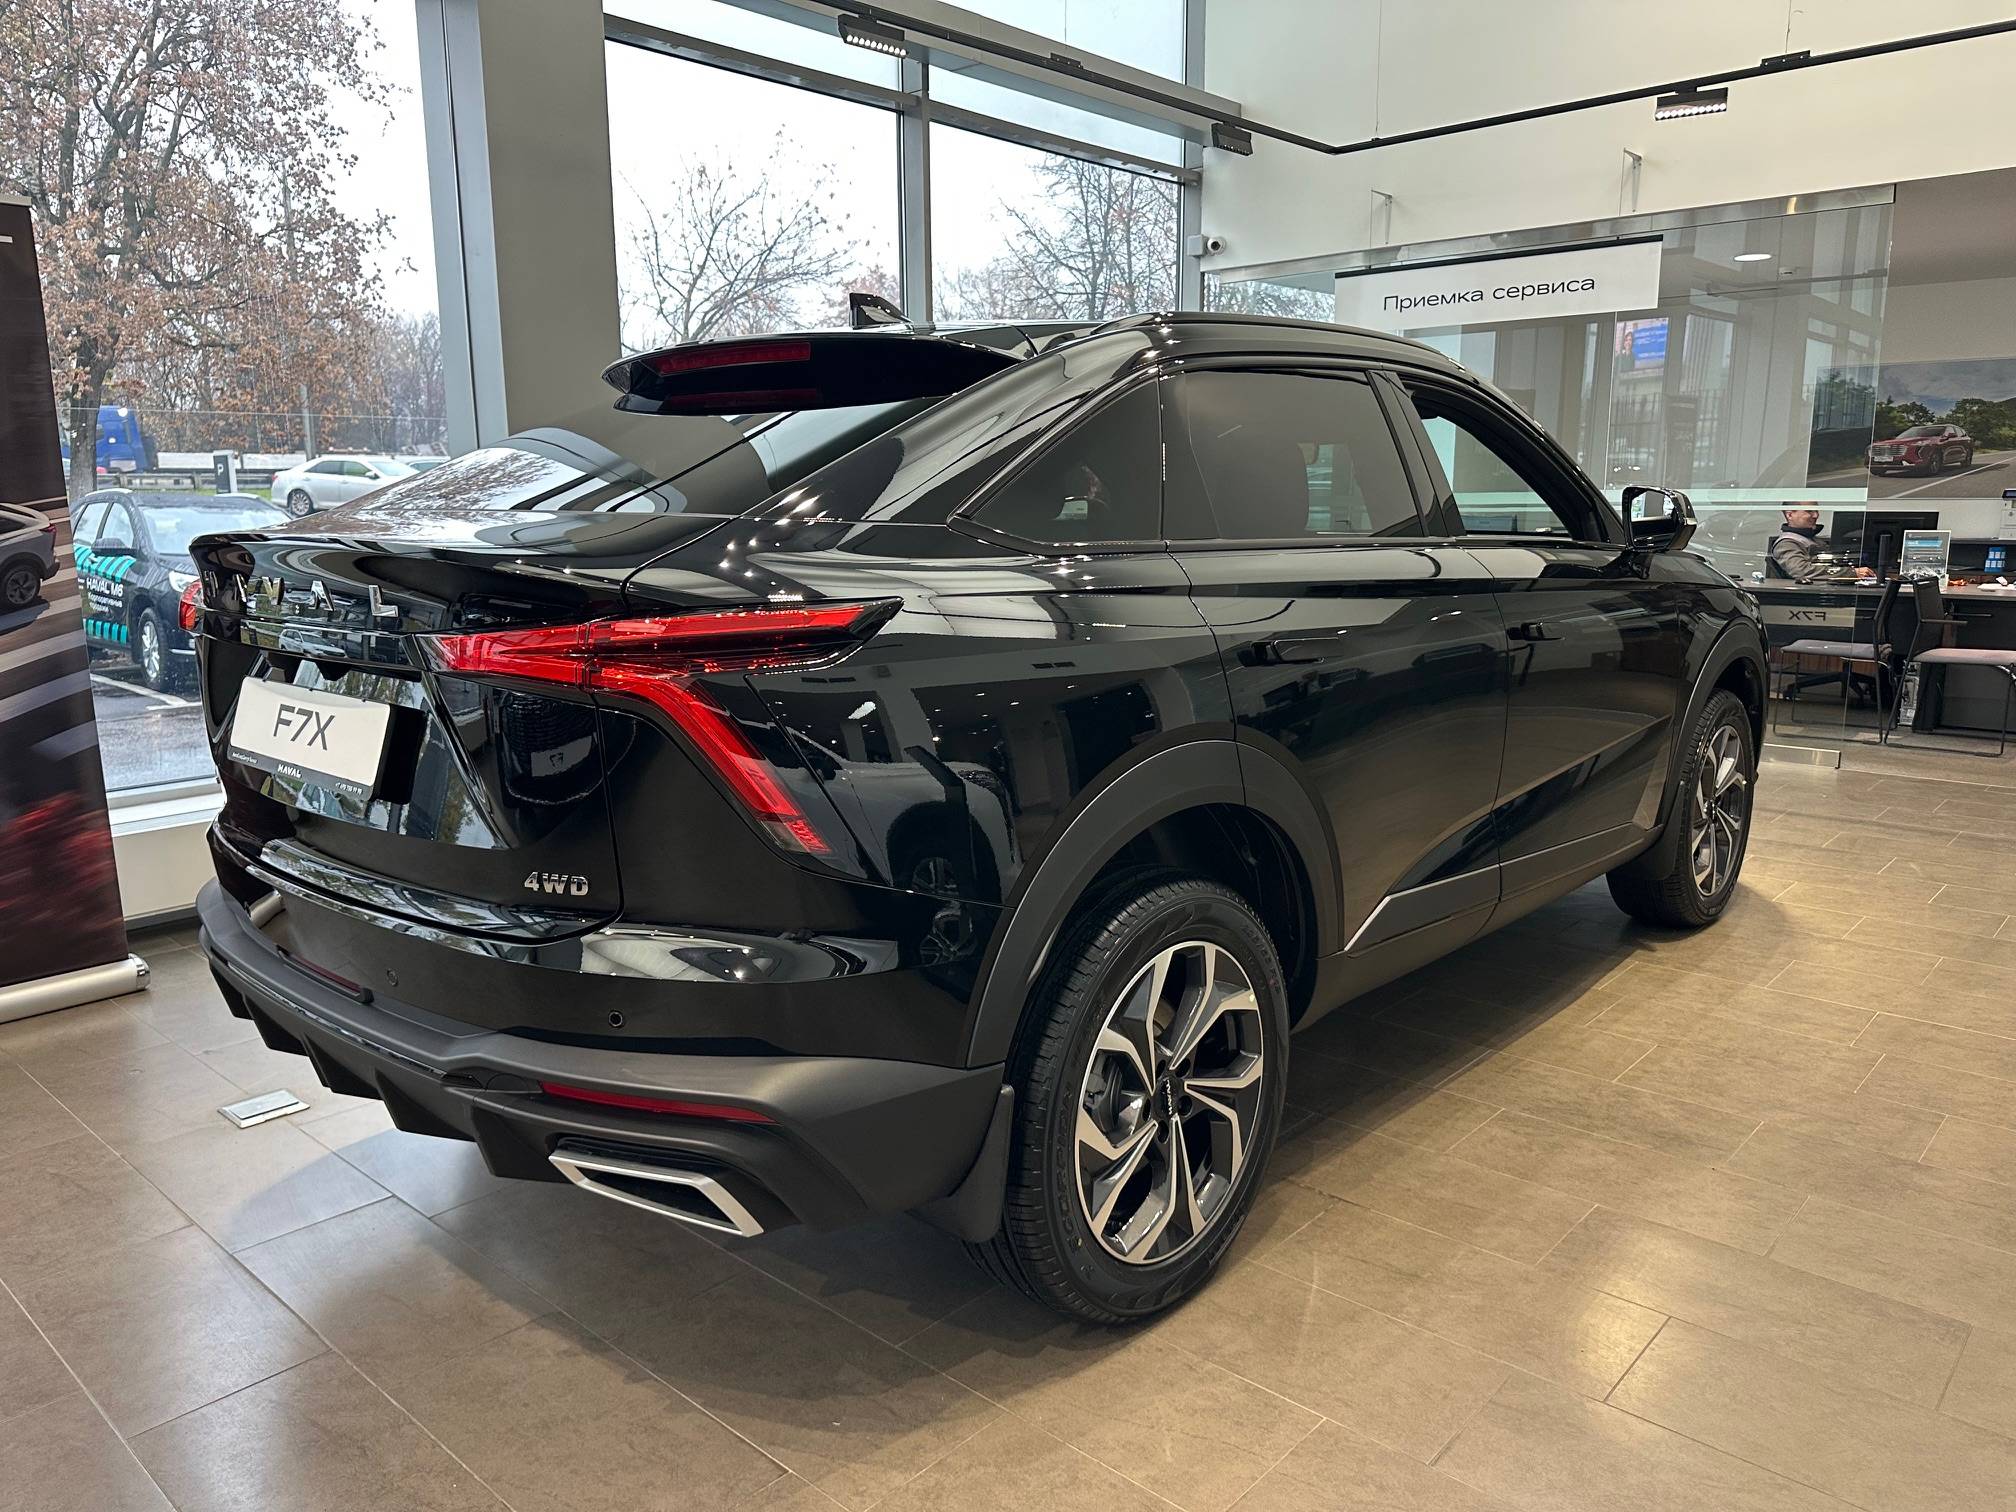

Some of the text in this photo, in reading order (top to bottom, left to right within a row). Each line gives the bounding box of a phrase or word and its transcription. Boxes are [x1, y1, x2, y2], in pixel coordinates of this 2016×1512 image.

[1383, 277, 1595, 312] Приемка сервиса
[86, 577, 110, 594] HAVAL
[273, 704, 335, 751] F7X
[277, 763, 302, 779] HAVAL
[525, 870, 589, 896] 4WD
